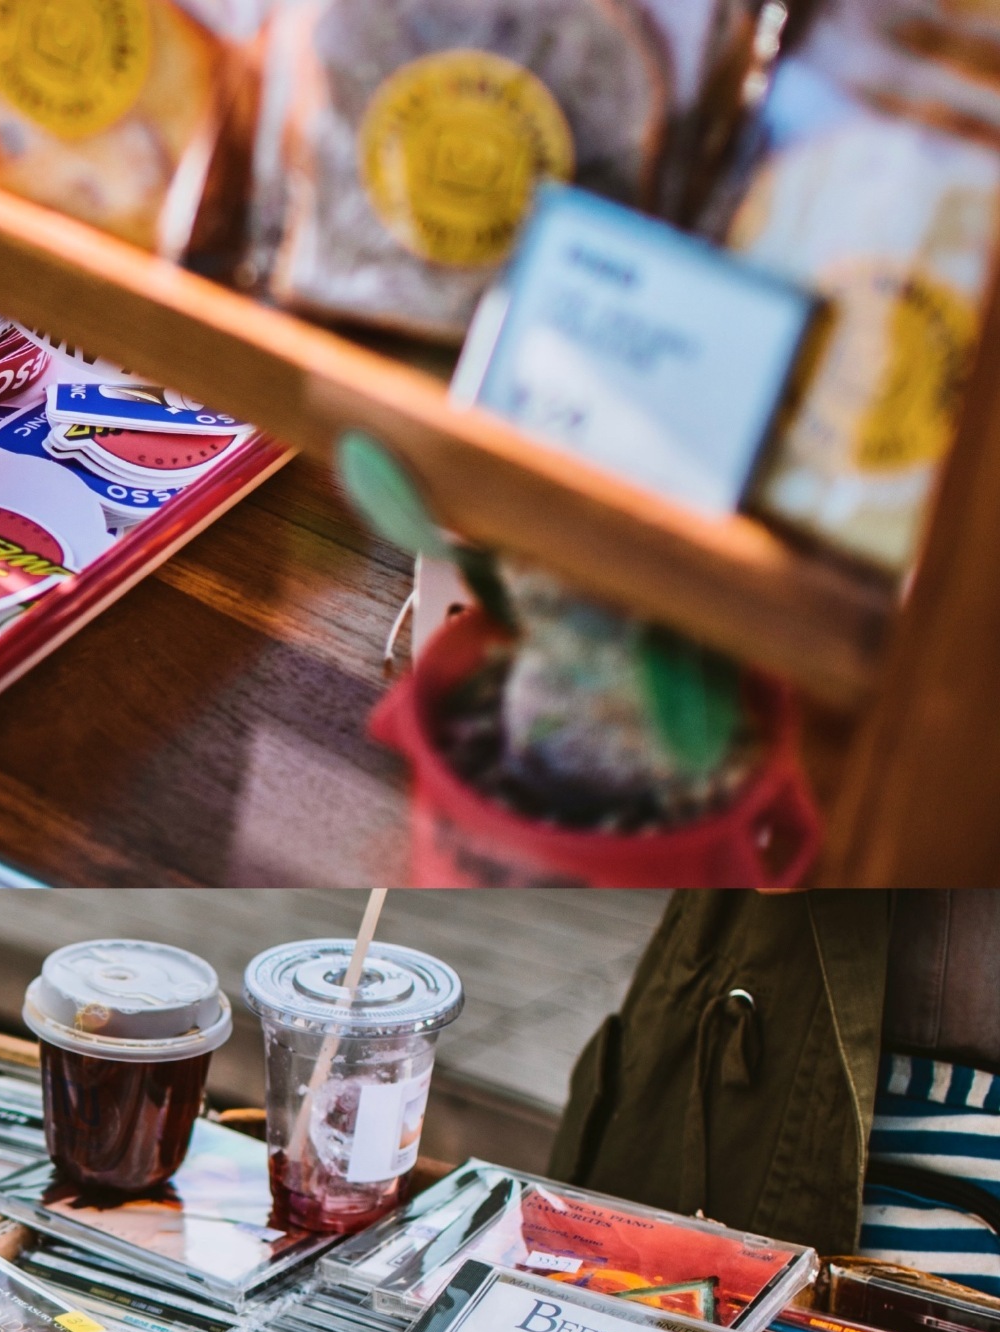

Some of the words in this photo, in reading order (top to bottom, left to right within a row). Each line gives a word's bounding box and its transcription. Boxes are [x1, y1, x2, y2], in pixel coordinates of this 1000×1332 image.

[136, 442, 219, 467] COFFEE
[610, 1214, 655, 1230] PIANO
[10, 1293, 54, 1324] TREASURY
[809, 1318, 844, 1332] DIMITRI
